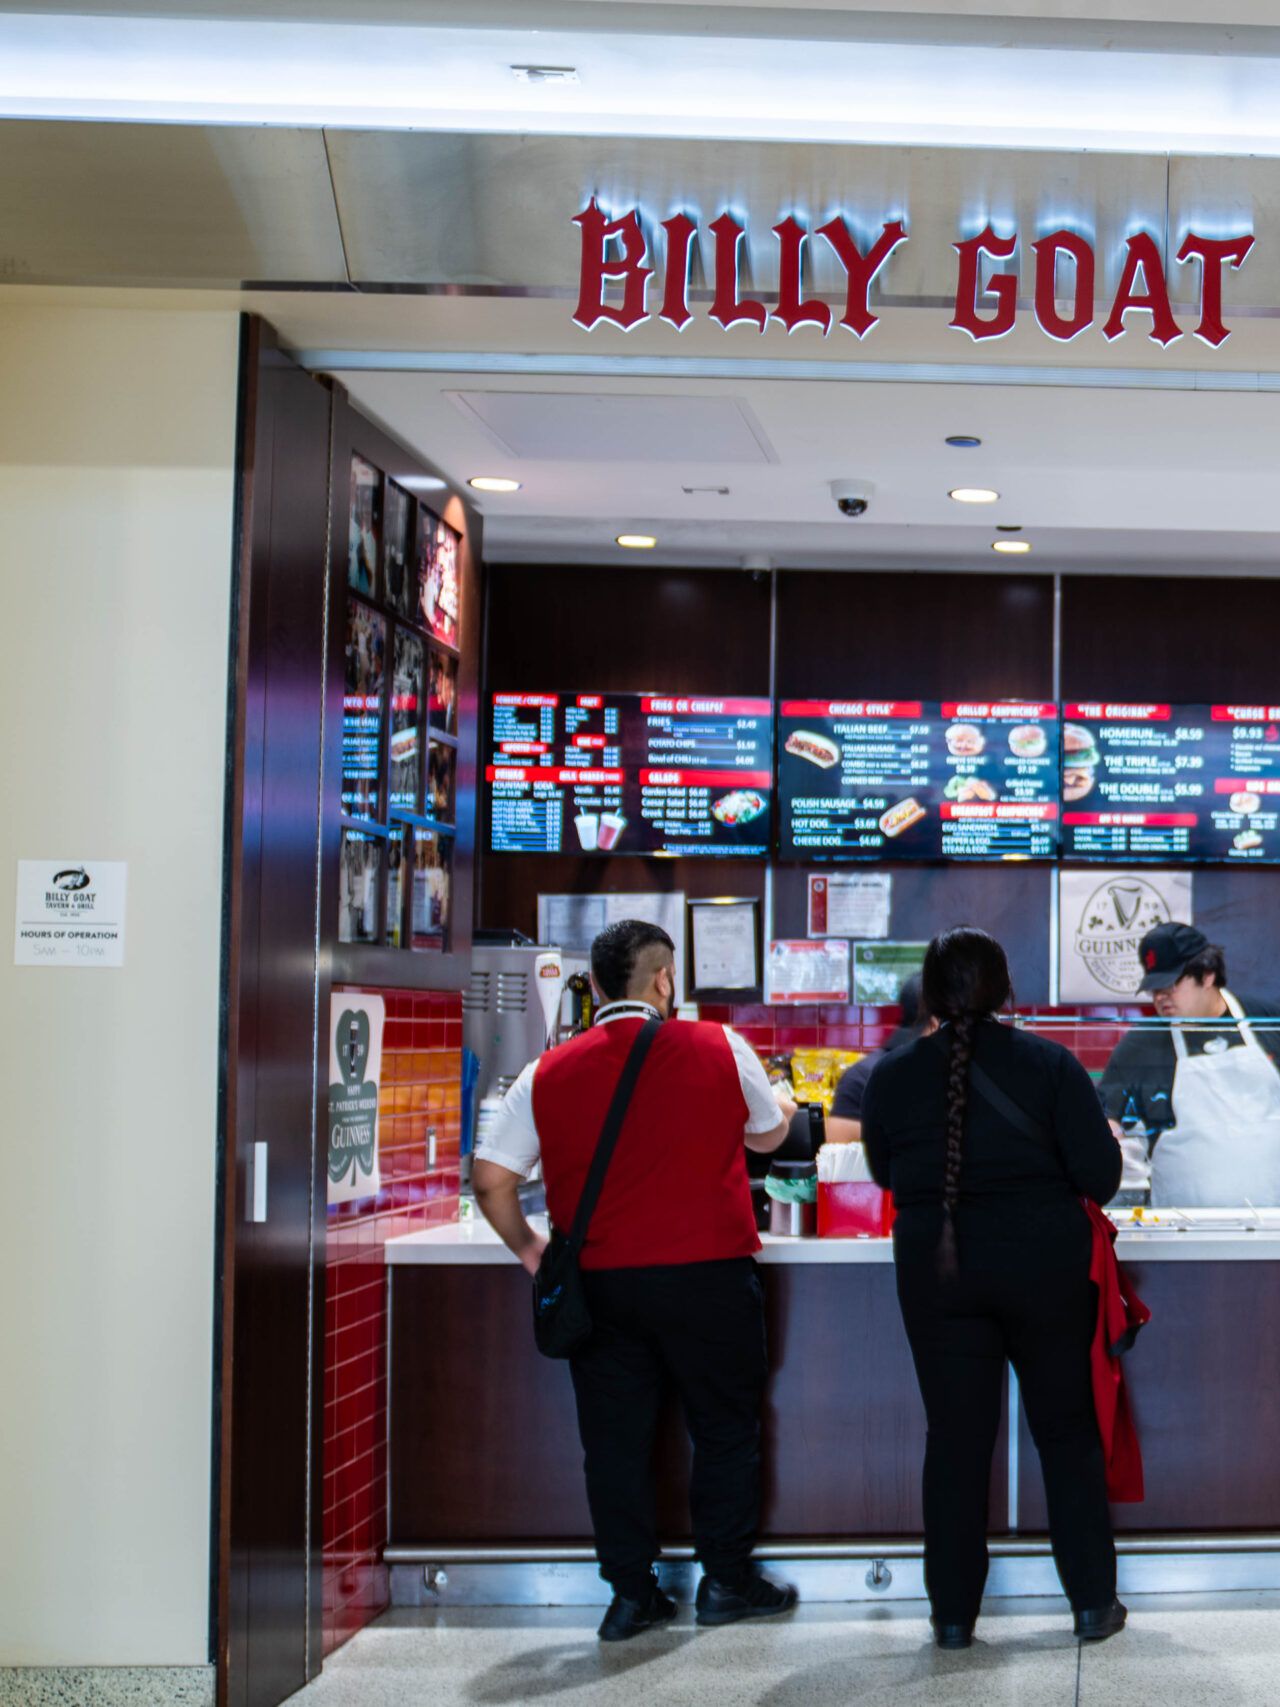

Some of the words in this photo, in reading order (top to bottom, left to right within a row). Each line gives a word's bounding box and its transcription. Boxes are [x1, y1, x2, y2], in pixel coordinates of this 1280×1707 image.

[571, 196, 909, 342] BILLY
[948, 224, 1256, 350] GOAT
[651, 699, 673, 711] FRIES
[676, 700, 688, 711] OR
[829, 703, 862, 714] CHICAGO
[647, 716, 671, 727] FRIES
[834, 724, 866, 733] ITALIAN
[868, 724, 888, 733] BEEF
[1100, 728, 1153, 738] HOMERUN
[648, 738, 675, 748] POTATO
[676, 739, 696, 748] CHIPS
[842, 744, 865, 752] ITALIAN
[867, 744, 896, 753] SAUSAGE
[648, 753, 666, 763] Bowl
[1104, 756, 1123, 766] THE
[1125, 756, 1158, 766] TRIPLE
[842, 760, 865, 768] COMBO
[649, 773, 679, 783] SALADS
[842, 777, 867, 785] CORNED
[868, 777, 883, 785] BEEF
[493, 781, 529, 790] FOUNTAIN
[533, 782, 553, 790] SODA
[1099, 783, 1118, 794] THE
[1120, 783, 1160, 794] DOUBLE
[642, 787, 666, 796] Garden
[667, 787, 685, 796] Salad
[642, 798, 665, 807] Caesar
[667, 798, 685, 807] Salad
[792, 799, 819, 808] POLISH
[820, 799, 856, 808] SAUSAGE
[642, 808, 663, 817] Greek
[666, 809, 685, 818] Salad
[792, 819, 808, 828] HOT
[810, 819, 828, 828] DOG
[793, 836, 821, 845] CHEESE
[823, 836, 841, 845] DOG
[45, 892, 70, 902] BILLY
[73, 893, 96, 902] GOAT
[1079, 938, 1143, 955] GUINN
[336, 1100, 358, 1112] PATRICK'S
[331, 1124, 371, 1149] GUINNESS
